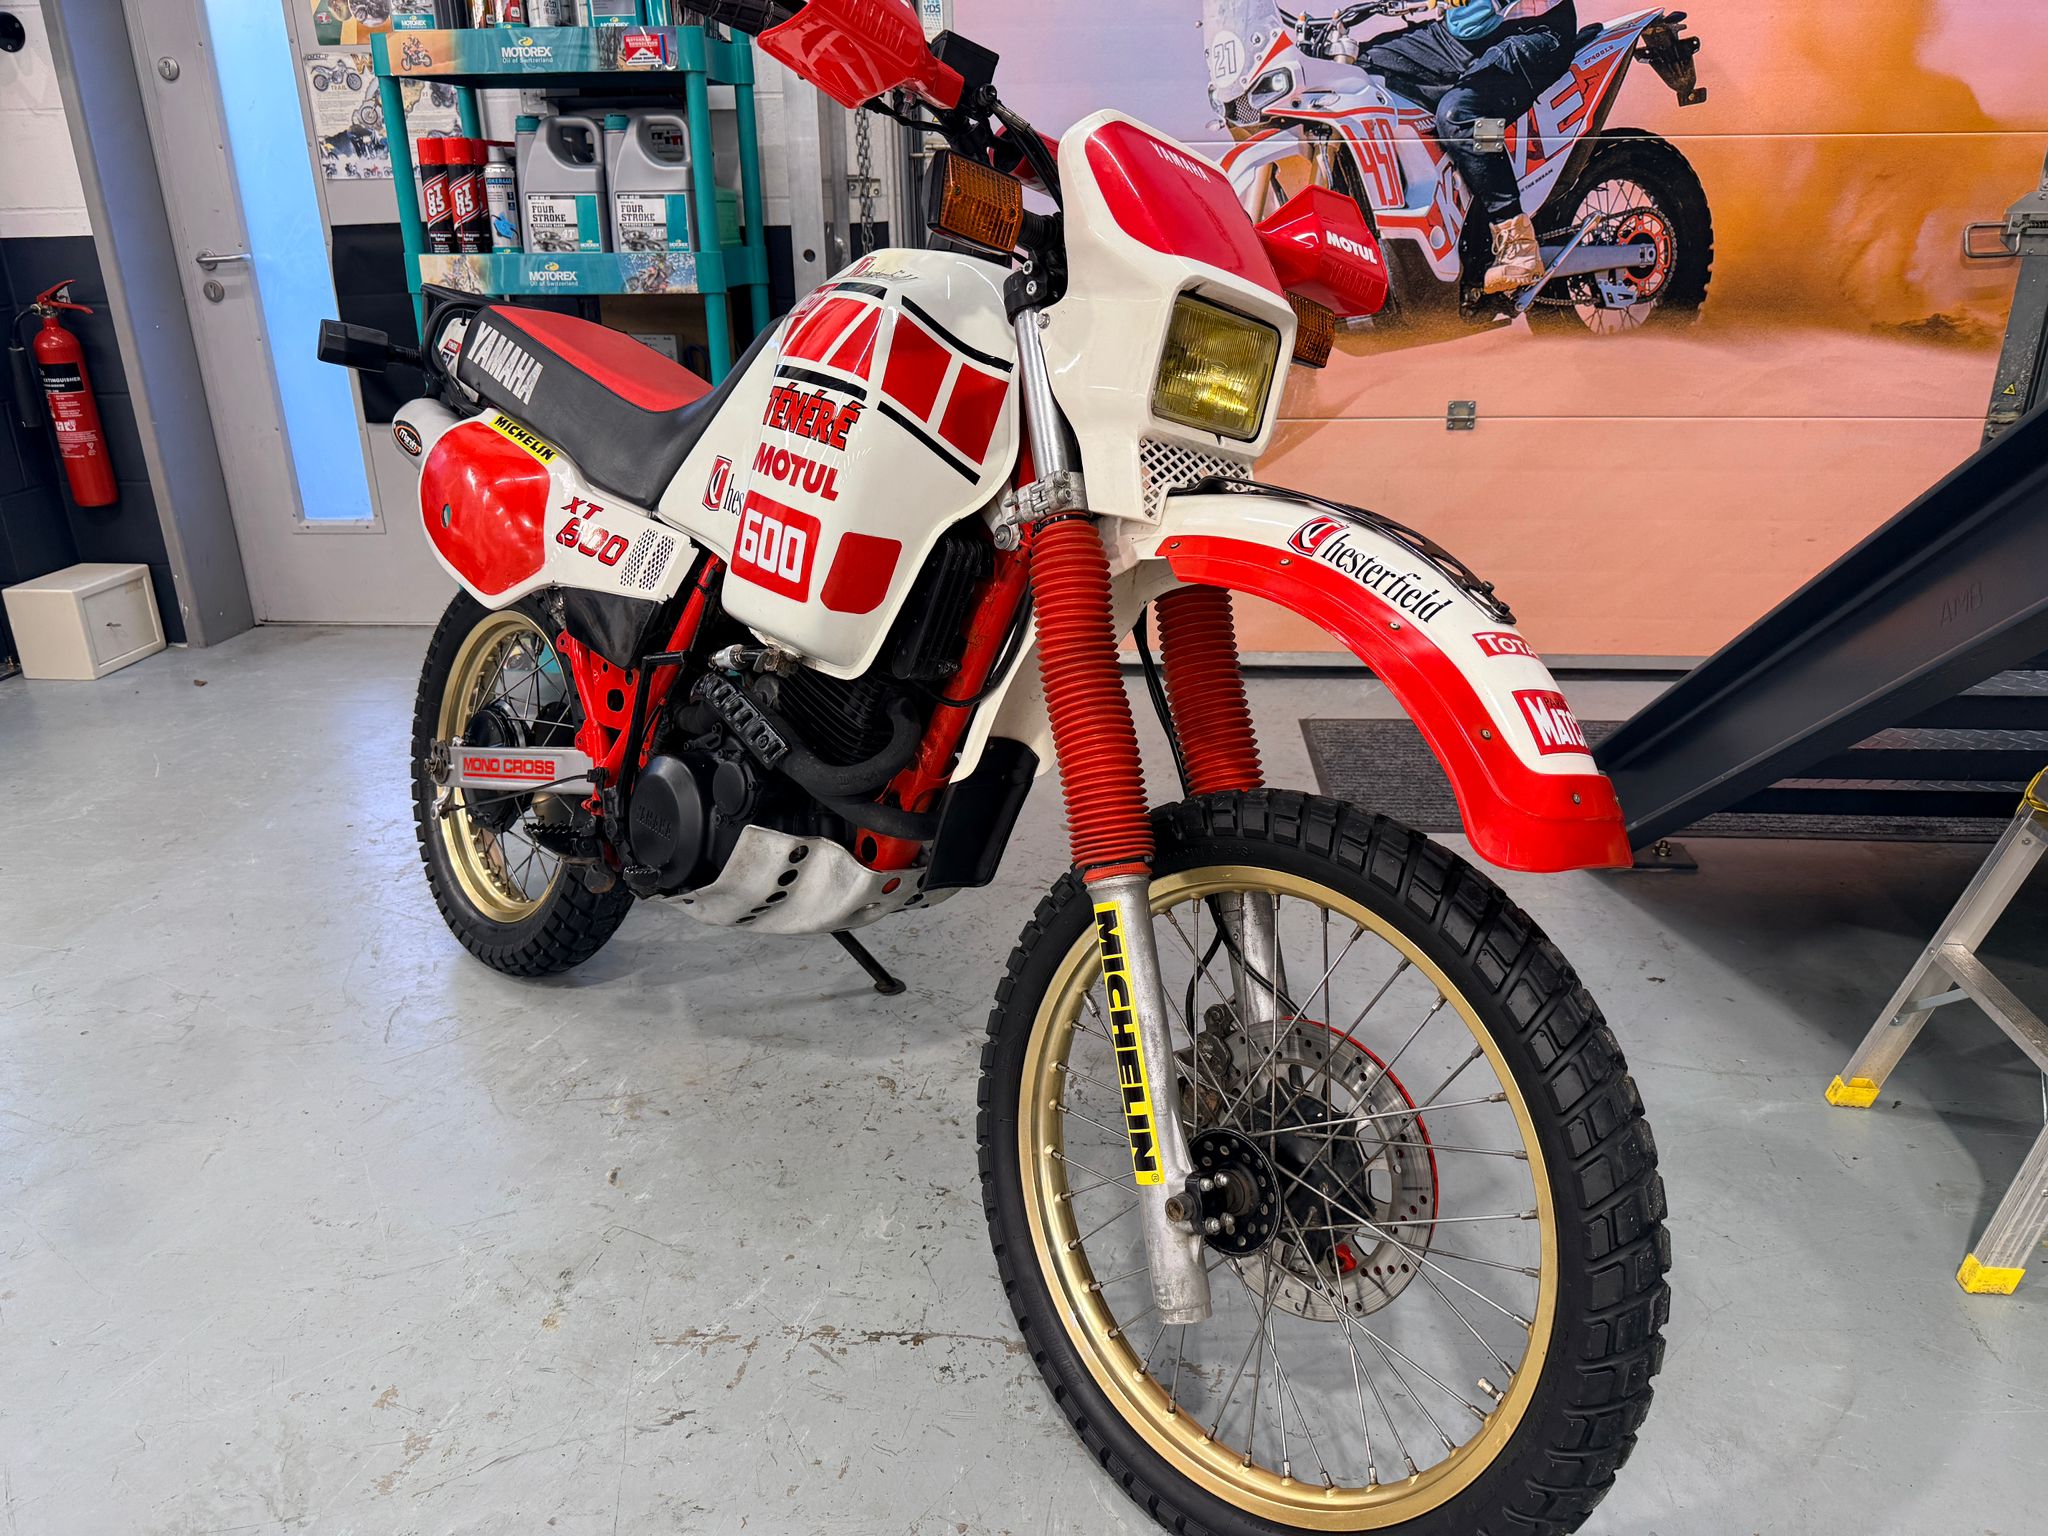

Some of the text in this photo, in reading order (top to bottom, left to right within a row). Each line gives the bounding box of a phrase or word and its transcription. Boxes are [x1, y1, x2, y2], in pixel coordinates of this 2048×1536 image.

[501, 46, 552, 57] MOTOREX
[1213, 40, 1237, 78] 21
[1149, 140, 1212, 183] YAMAHA
[426, 182, 443, 200] GT
[454, 182, 471, 200] GT
[428, 199, 446, 217] 85
[456, 199, 474, 217] 85
[532, 205, 555, 214] FOUR
[532, 214, 566, 222] STROKE
[621, 204, 644, 213] FOUR
[621, 213, 656, 222] STROKE
[1326, 230, 1378, 265] MOTUL
[528, 271, 577, 281] MOTOREX
[467, 320, 544, 406] YAMAHA
[494, 416, 556, 461] MICHELIN
[752, 442, 840, 501] MOTUL
[560, 496, 604, 520] XT
[555, 517, 630, 567] 600
[738, 507, 808, 584] 600
[1287, 515, 1453, 624] Chesterfield
[1476, 634, 1539, 659] TOTA
[463, 756, 556, 776] MONO CROSS
[1096, 909, 1157, 1172] MICHELIN
